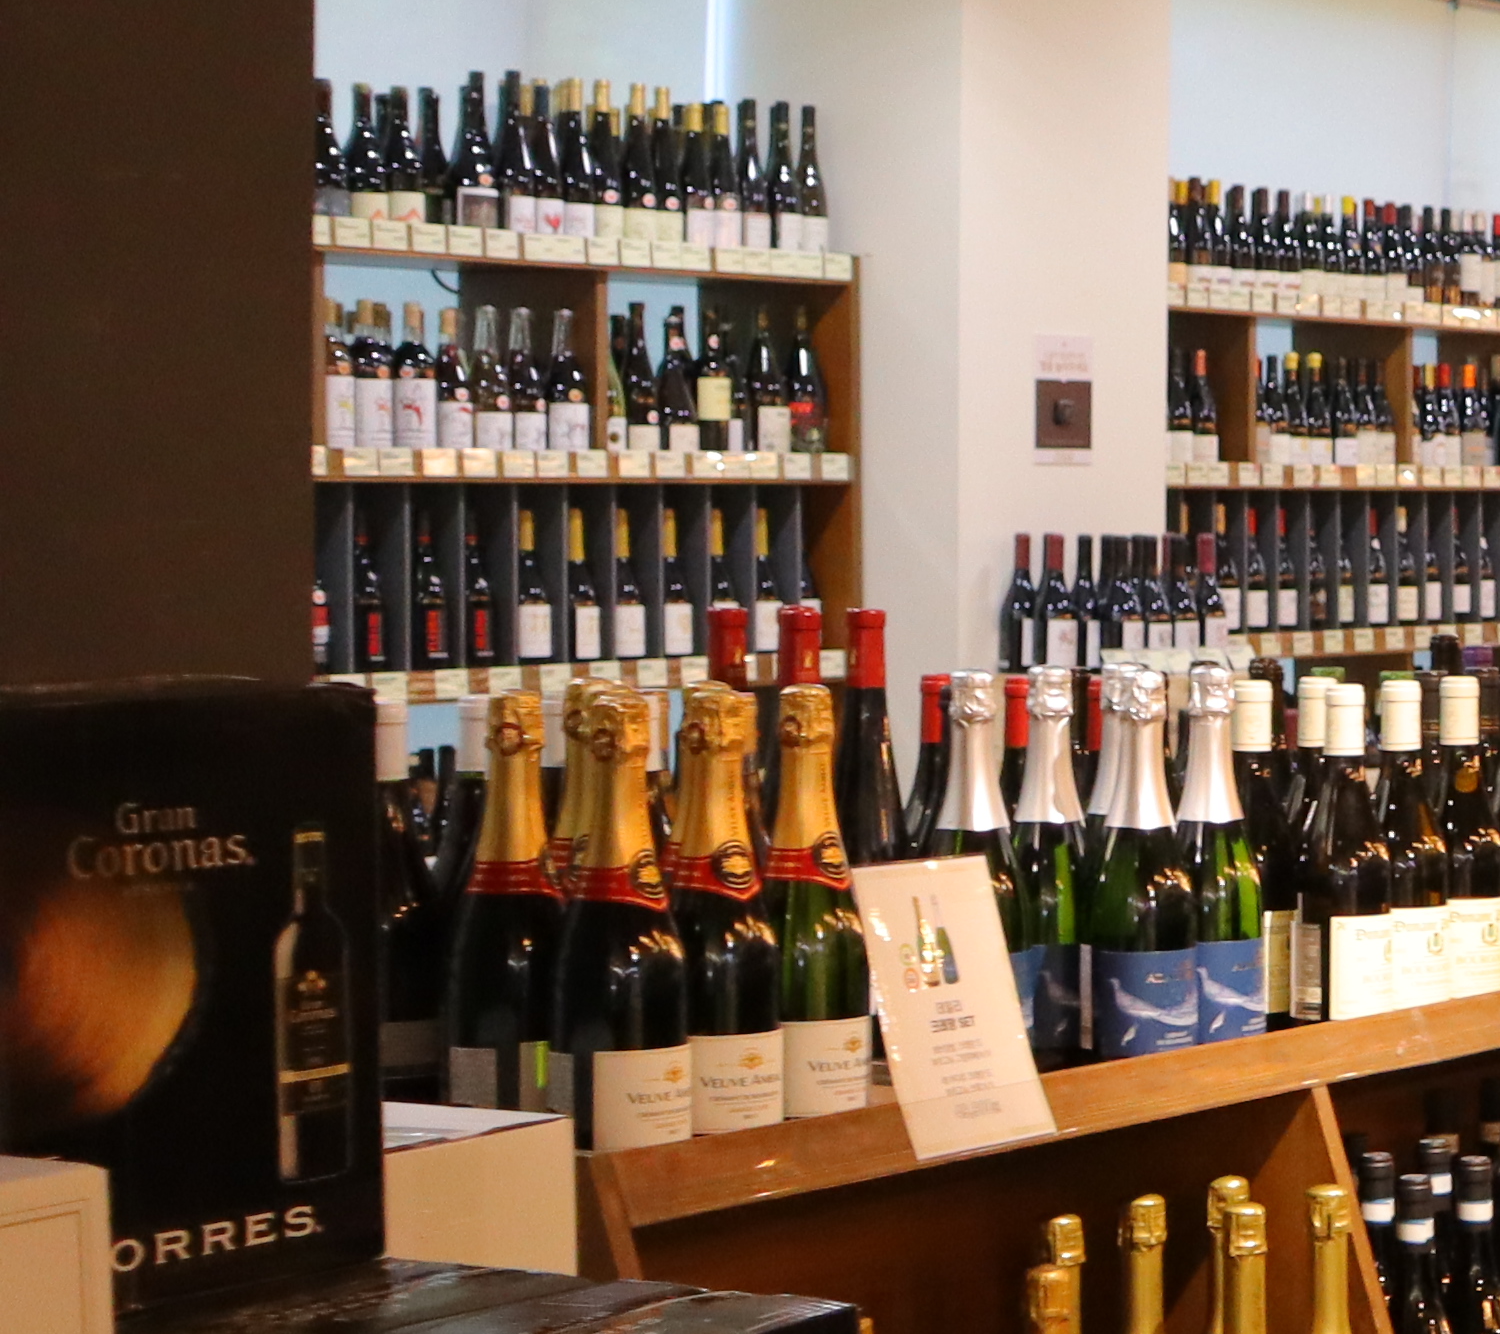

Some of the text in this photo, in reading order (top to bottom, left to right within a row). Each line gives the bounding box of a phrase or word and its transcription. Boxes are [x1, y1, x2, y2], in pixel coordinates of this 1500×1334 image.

[115, 802, 196, 836] Gran
[67, 833, 248, 880] Coronas
[112, 1204, 318, 1273] ORRES
